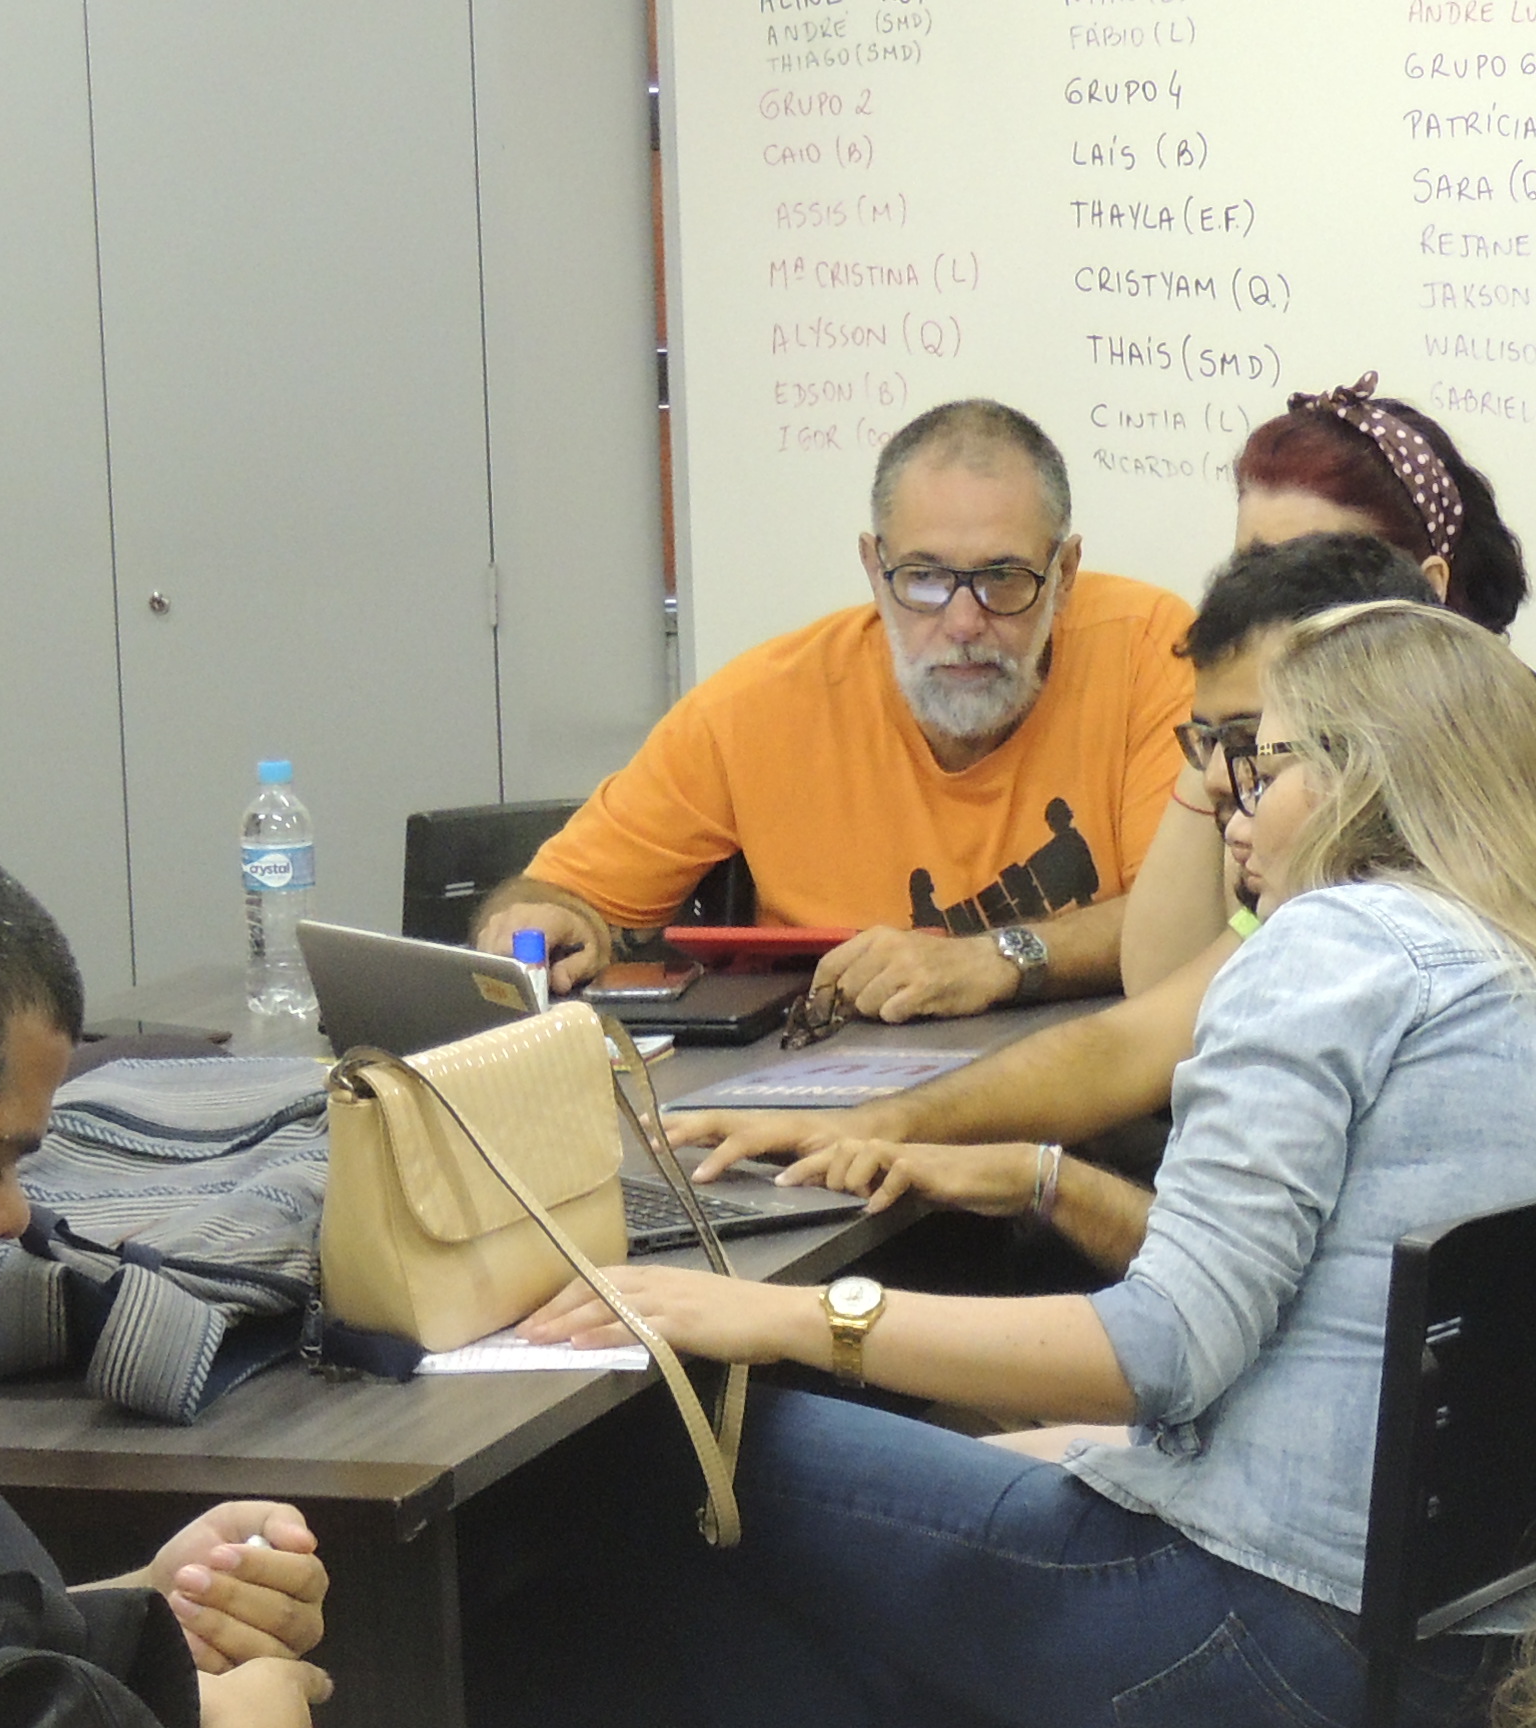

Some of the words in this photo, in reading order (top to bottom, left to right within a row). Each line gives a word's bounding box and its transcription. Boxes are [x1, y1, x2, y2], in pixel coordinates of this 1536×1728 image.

[875, 9, 932, 36] (SMD)
[1403, 54, 1507, 79] GRUPO
[1520, 52, 1536, 76] 6
[760, 88, 842, 120] GRUPO
[855, 88, 874, 115] 2
[1065, 77, 1157, 104] GRUPO
[1169, 69, 1181, 109] 4
[764, 143, 821, 165] CAIO
[836, 135, 873, 169] (B)
[1157, 131, 1207, 170] (B)
[1413, 168, 1493, 203] SARA
[1420, 224, 1530, 259] REJANE
[816, 261, 918, 288] CRISTINA
[934, 252, 978, 294] (L)
[1075, 266, 1216, 300] CRISTYAM
[1419, 282, 1530, 308] JAKSON
[773, 316, 887, 355] ALYSSON
[903, 312, 961, 357] (Q)
[775, 380, 852, 408] EDSON
[779, 425, 842, 452] IGOR
[1094, 449, 1193, 478] RICARDO
